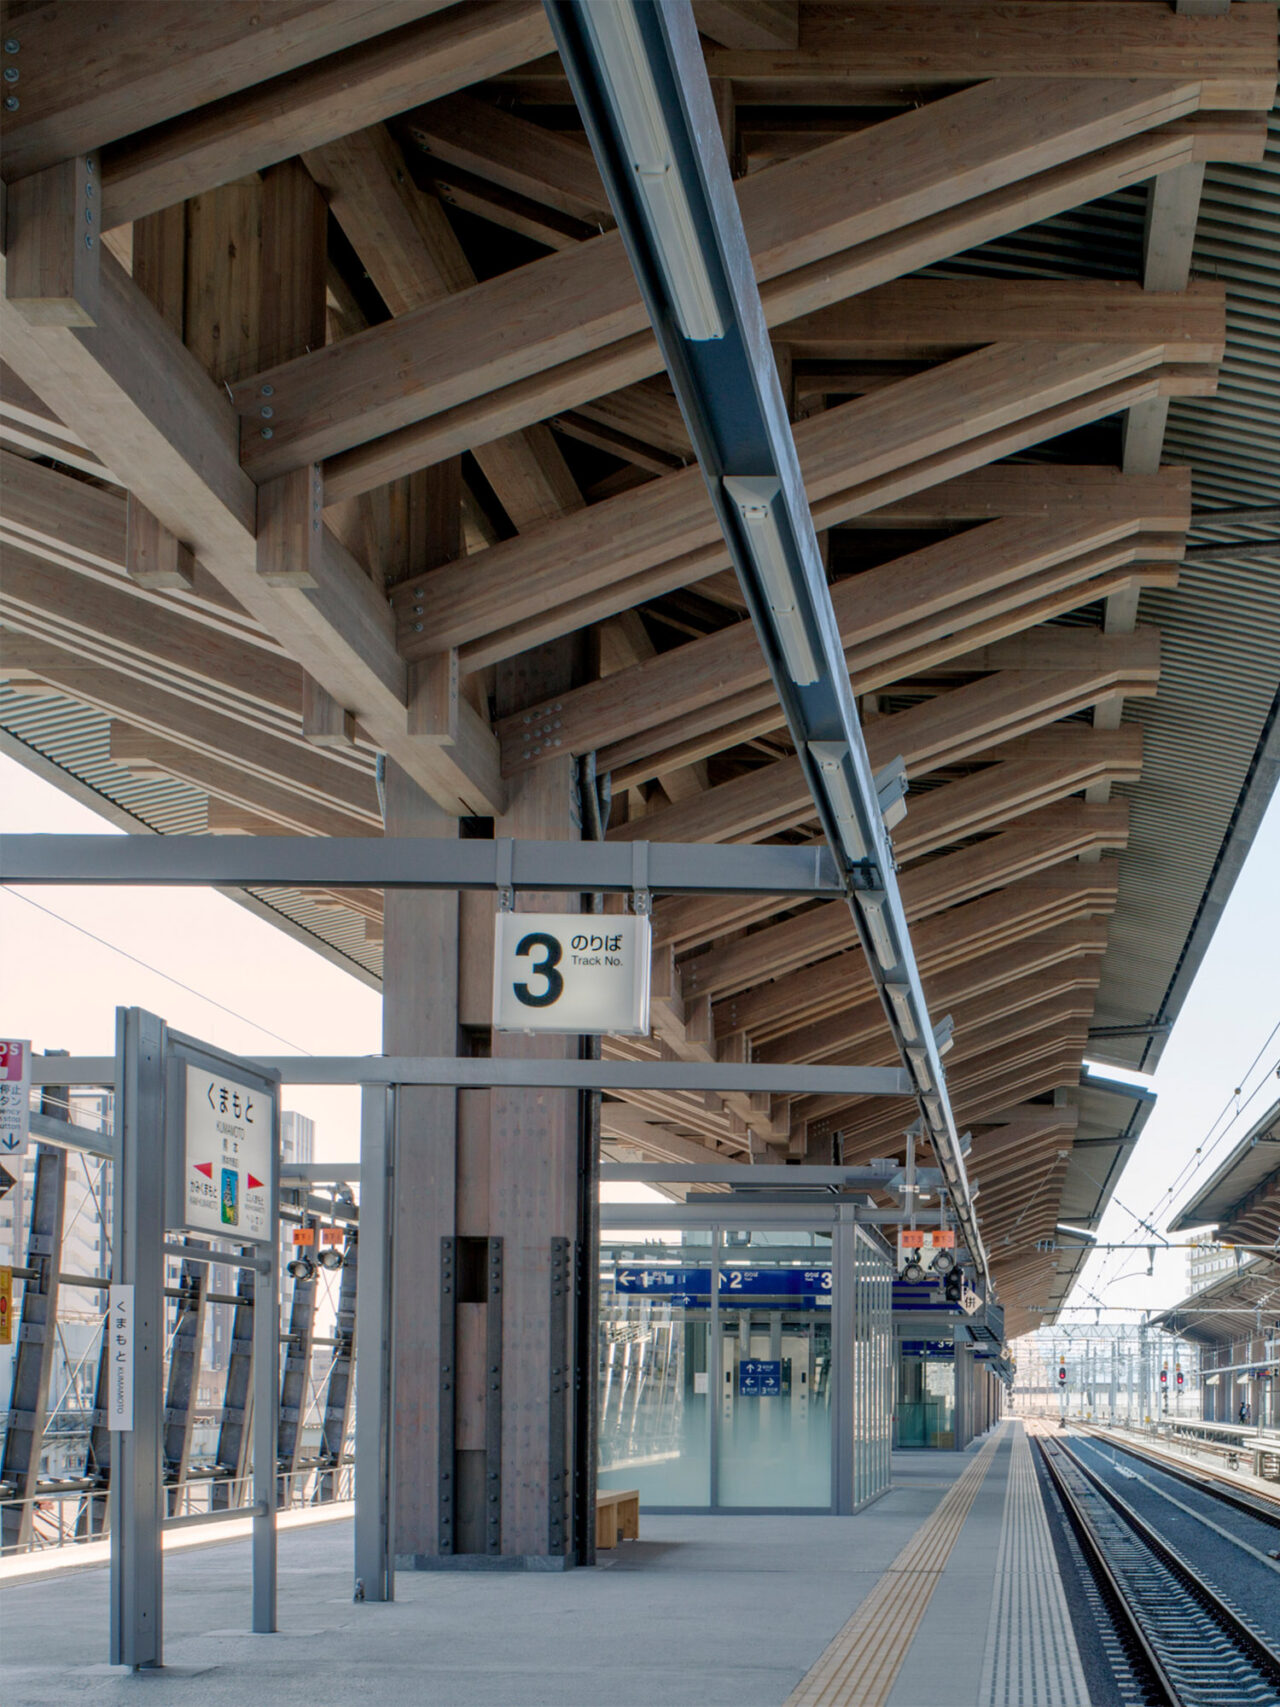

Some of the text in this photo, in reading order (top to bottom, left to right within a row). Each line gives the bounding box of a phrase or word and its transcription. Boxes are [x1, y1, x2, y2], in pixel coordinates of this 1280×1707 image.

[571, 934, 623, 951] のりば
[571, 955, 623, 967] Track No.
[513, 932, 564, 1008] 3
[207, 1082, 253, 1123] くまもと
[640, 1271, 648, 1288] 1
[730, 1271, 742, 1288] 2
[821, 1271, 832, 1288] 3
[965, 1296, 976, 1309] 併
[116, 1301, 127, 1414] くまもと KUMAMOTO
[757, 1364, 762, 1372] 2
